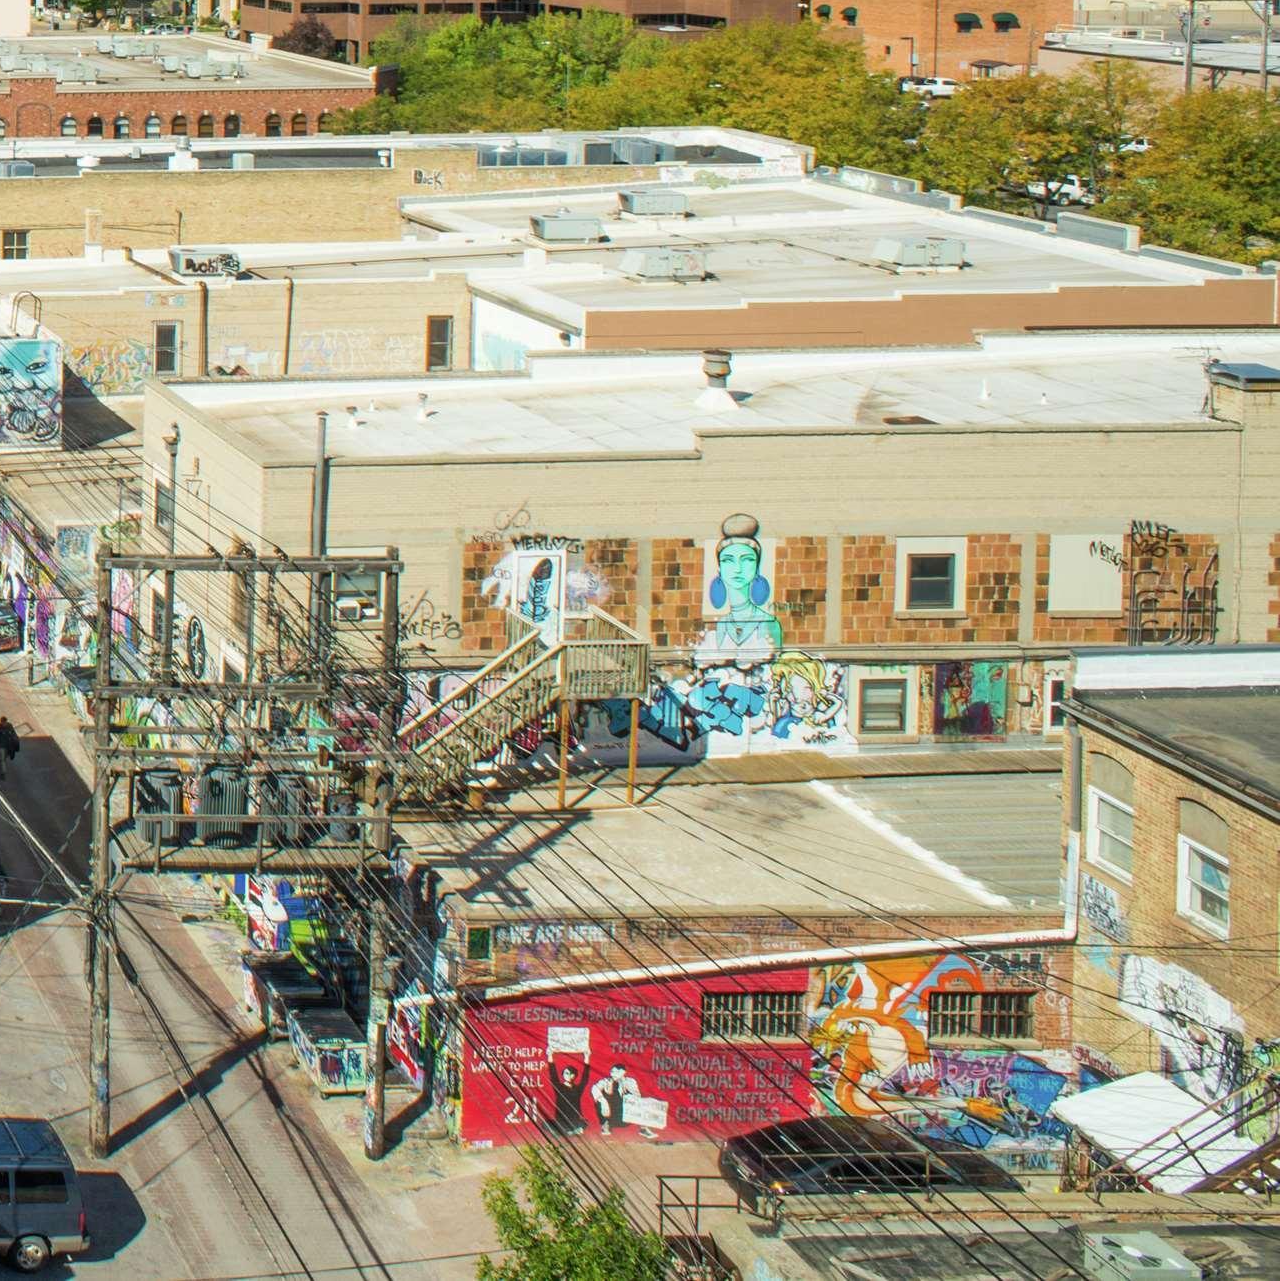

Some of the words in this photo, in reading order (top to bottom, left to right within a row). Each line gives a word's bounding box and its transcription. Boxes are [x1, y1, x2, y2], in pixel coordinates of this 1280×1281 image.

[476, 1006, 583, 1023] HOMELESSNESS
[605, 1005, 691, 1022] COMMUNITY
[619, 1022, 666, 1039] ISSUE
[473, 1045, 512, 1059] NEED
[514, 1047, 544, 1058] HELP?
[610, 1041, 647, 1053] THAT
[471, 1061, 504, 1073] WANT
[508, 1061, 522, 1071] TO
[523, 1061, 546, 1071] HELP
[509, 1074, 545, 1088] CALL
[754, 1074, 794, 1089] ISSUE
[689, 1091, 725, 1104] THAT
[733, 1092, 795, 1104] AFFECTS
[675, 1107, 781, 1123] COMMUNITIES
